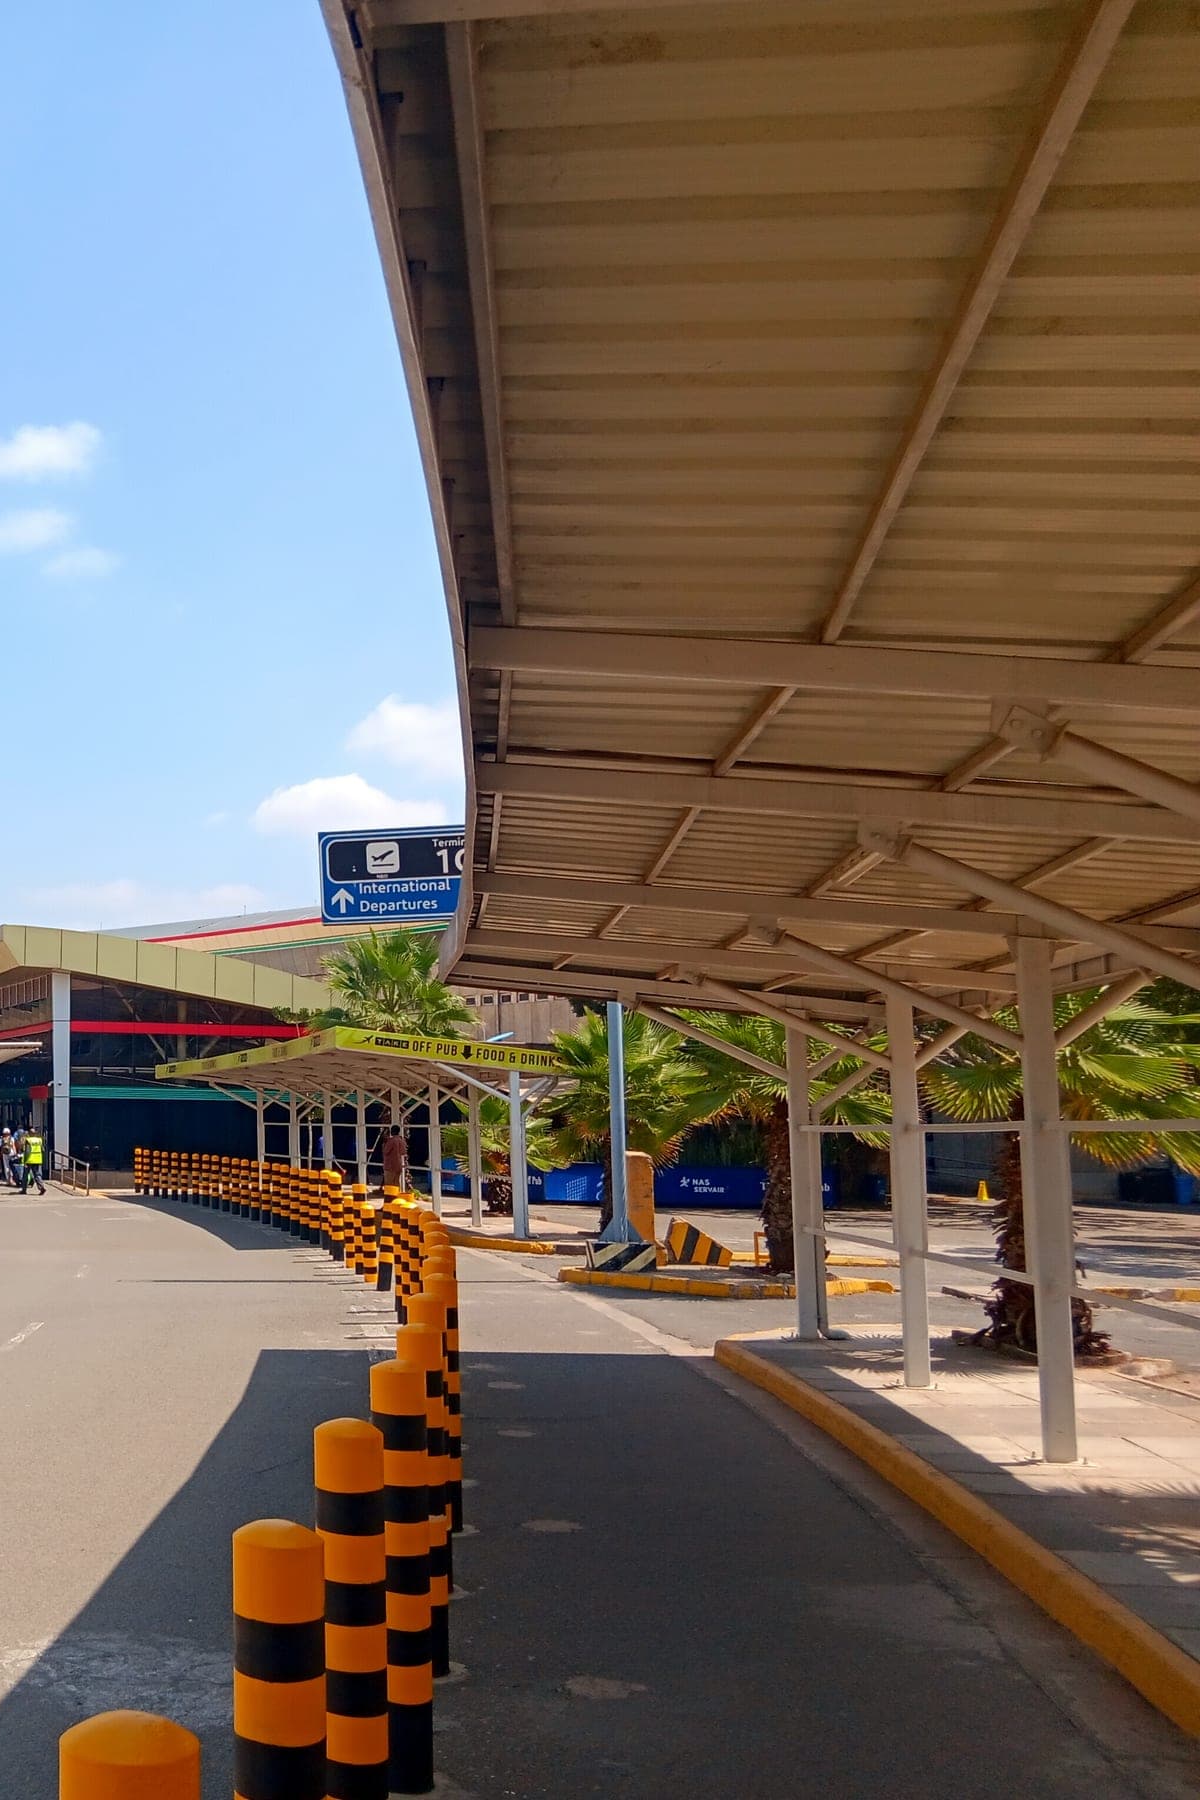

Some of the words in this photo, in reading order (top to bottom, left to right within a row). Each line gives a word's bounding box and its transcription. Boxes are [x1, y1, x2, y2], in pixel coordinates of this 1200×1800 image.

[359, 879, 450, 894] International
[360, 899, 438, 914] Departures
[376, 1038, 408, 1048] TAKE
[412, 1040, 432, 1053] OFF
[436, 1044, 458, 1057] PUB
[476, 1048, 505, 1062] FOOD
[509, 1052, 516, 1063] &
